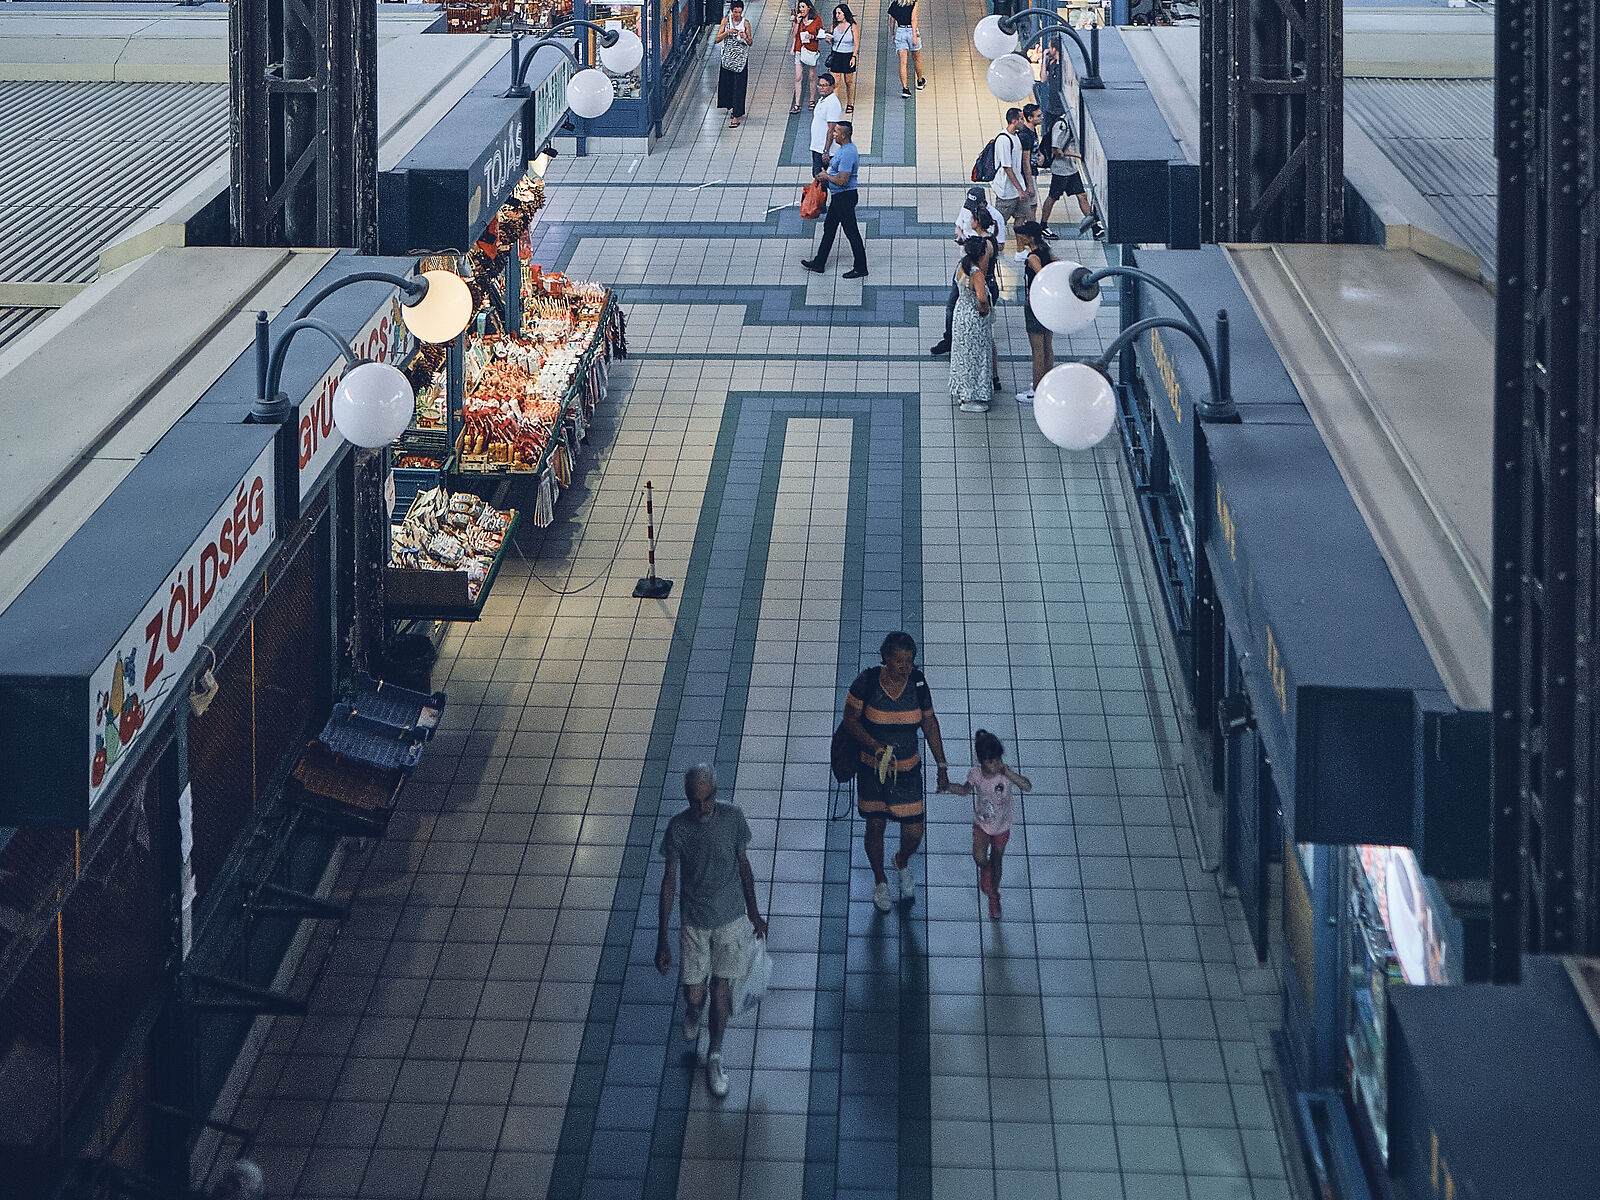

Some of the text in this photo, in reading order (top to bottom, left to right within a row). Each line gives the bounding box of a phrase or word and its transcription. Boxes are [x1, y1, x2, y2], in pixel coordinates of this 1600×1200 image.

[483, 120, 523, 208] TOJÁS
[299, 316, 388, 470] GYÜLCS
[144, 475, 264, 693] ZÖLDSÉG
